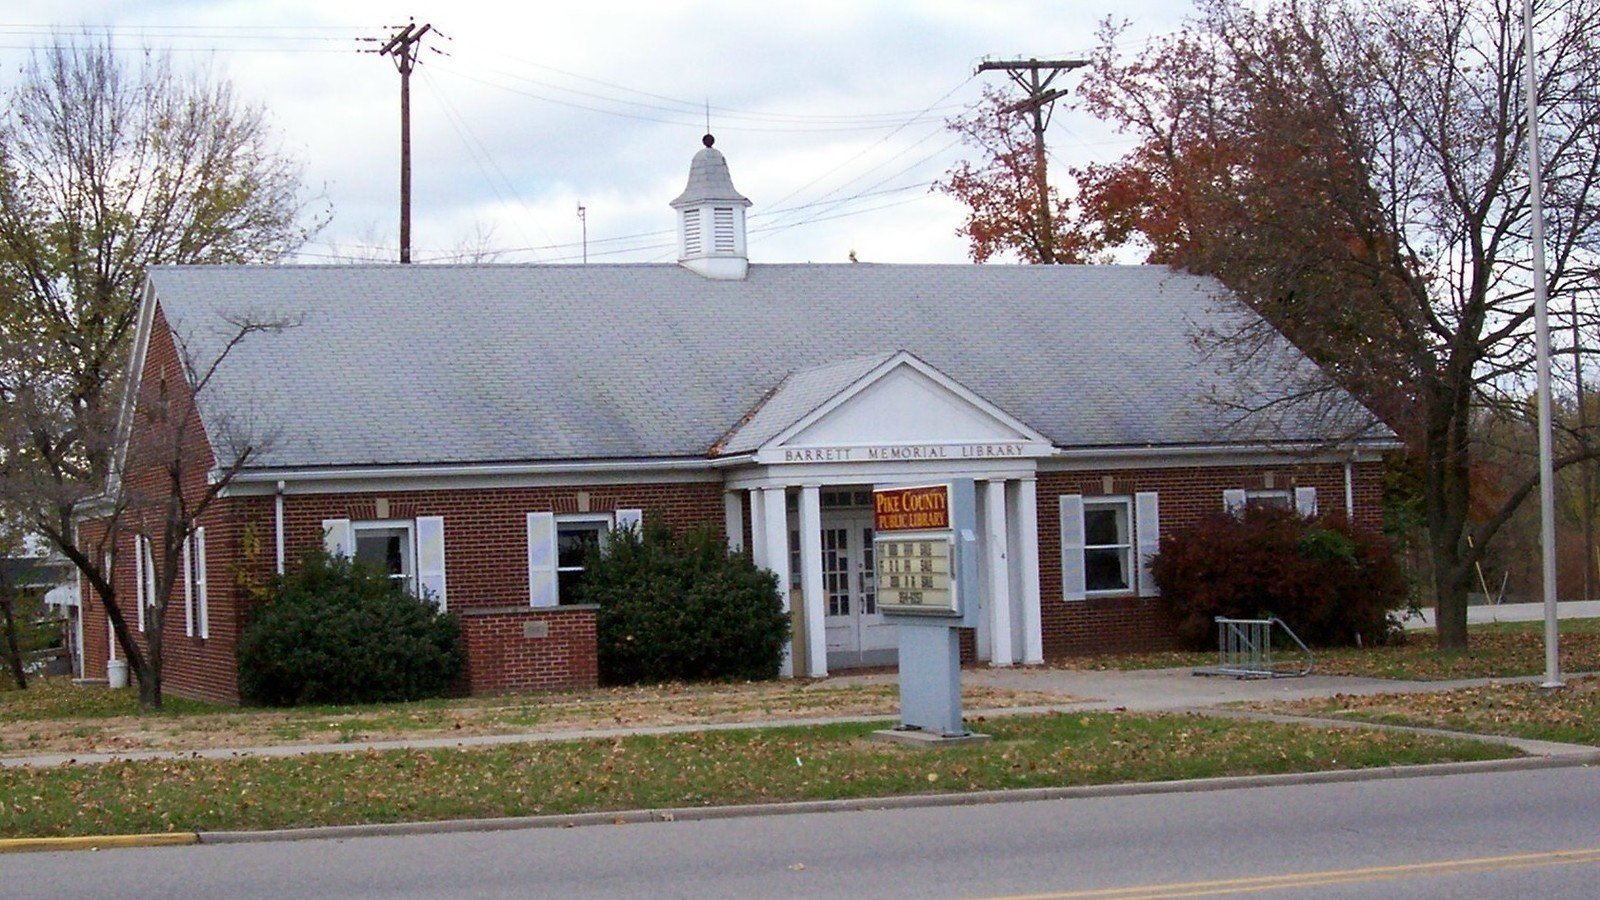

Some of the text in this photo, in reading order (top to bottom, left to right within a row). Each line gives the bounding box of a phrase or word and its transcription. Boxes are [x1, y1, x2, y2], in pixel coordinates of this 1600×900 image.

[785, 444, 1025, 461] BARRETT MEMORIAL LIBRARY
[876, 491, 946, 513] PIKE COUNTY
[879, 511, 945, 529] PUBLIC LIBRARY
